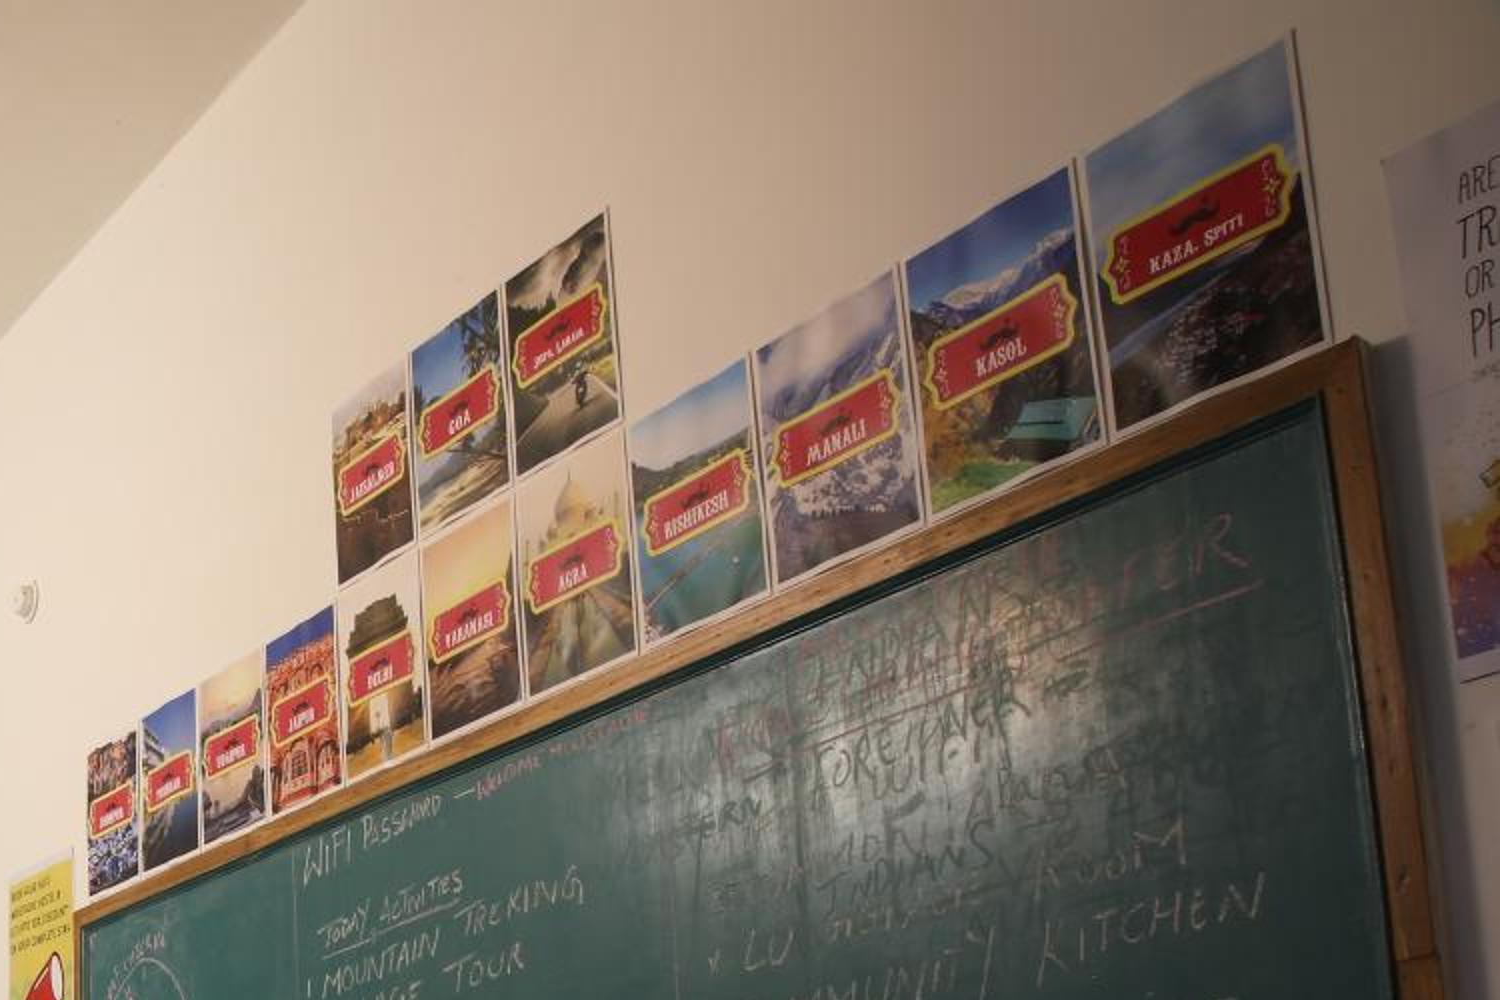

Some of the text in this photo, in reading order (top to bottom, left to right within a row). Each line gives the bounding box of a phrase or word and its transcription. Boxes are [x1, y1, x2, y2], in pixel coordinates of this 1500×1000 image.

[1203, 212, 1244, 247] SPITI
[1465, 258, 1495, 299] OR
[974, 337, 1028, 378] KASOL
[448, 410, 471, 436] GOA
[805, 418, 867, 466] MANALI
[663, 490, 729, 540] RISHIKESH
[558, 563, 589, 589] AGRA
[303, 823, 351, 885] WIFI
[1036, 869, 1267, 990] KITCHEN
[321, 927, 439, 999] MOUNTAIN
[441, 941, 526, 993] TOUR
